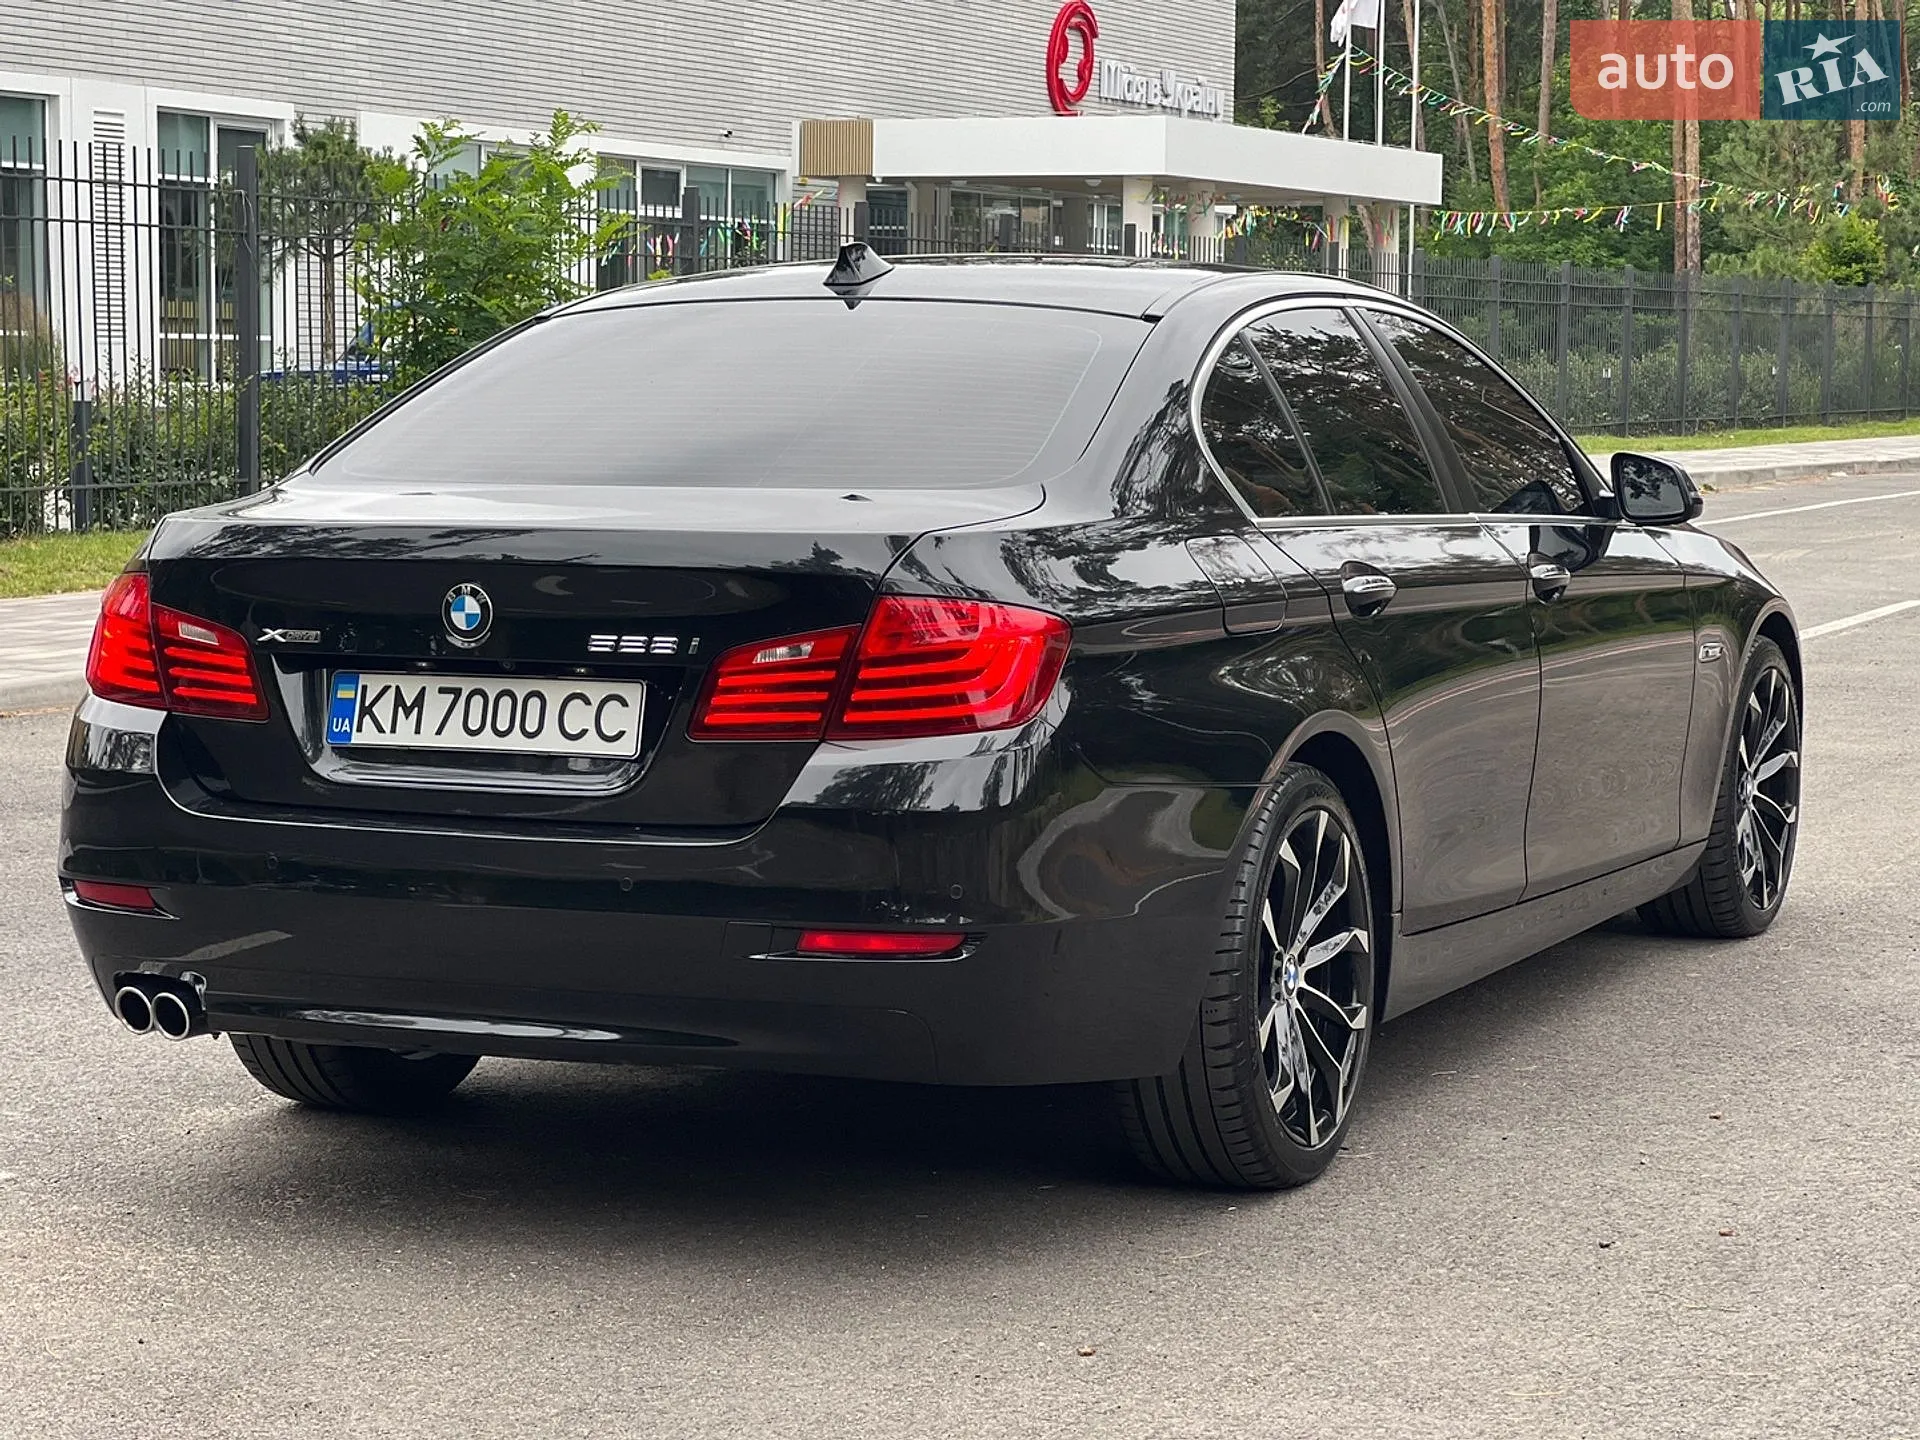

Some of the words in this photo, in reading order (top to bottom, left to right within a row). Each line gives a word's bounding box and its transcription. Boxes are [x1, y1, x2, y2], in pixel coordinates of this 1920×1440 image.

[332, 717, 350, 733] UA
[356, 684, 427, 735] KM
[434, 686, 547, 739] 7000
[558, 692, 629, 743] CC
